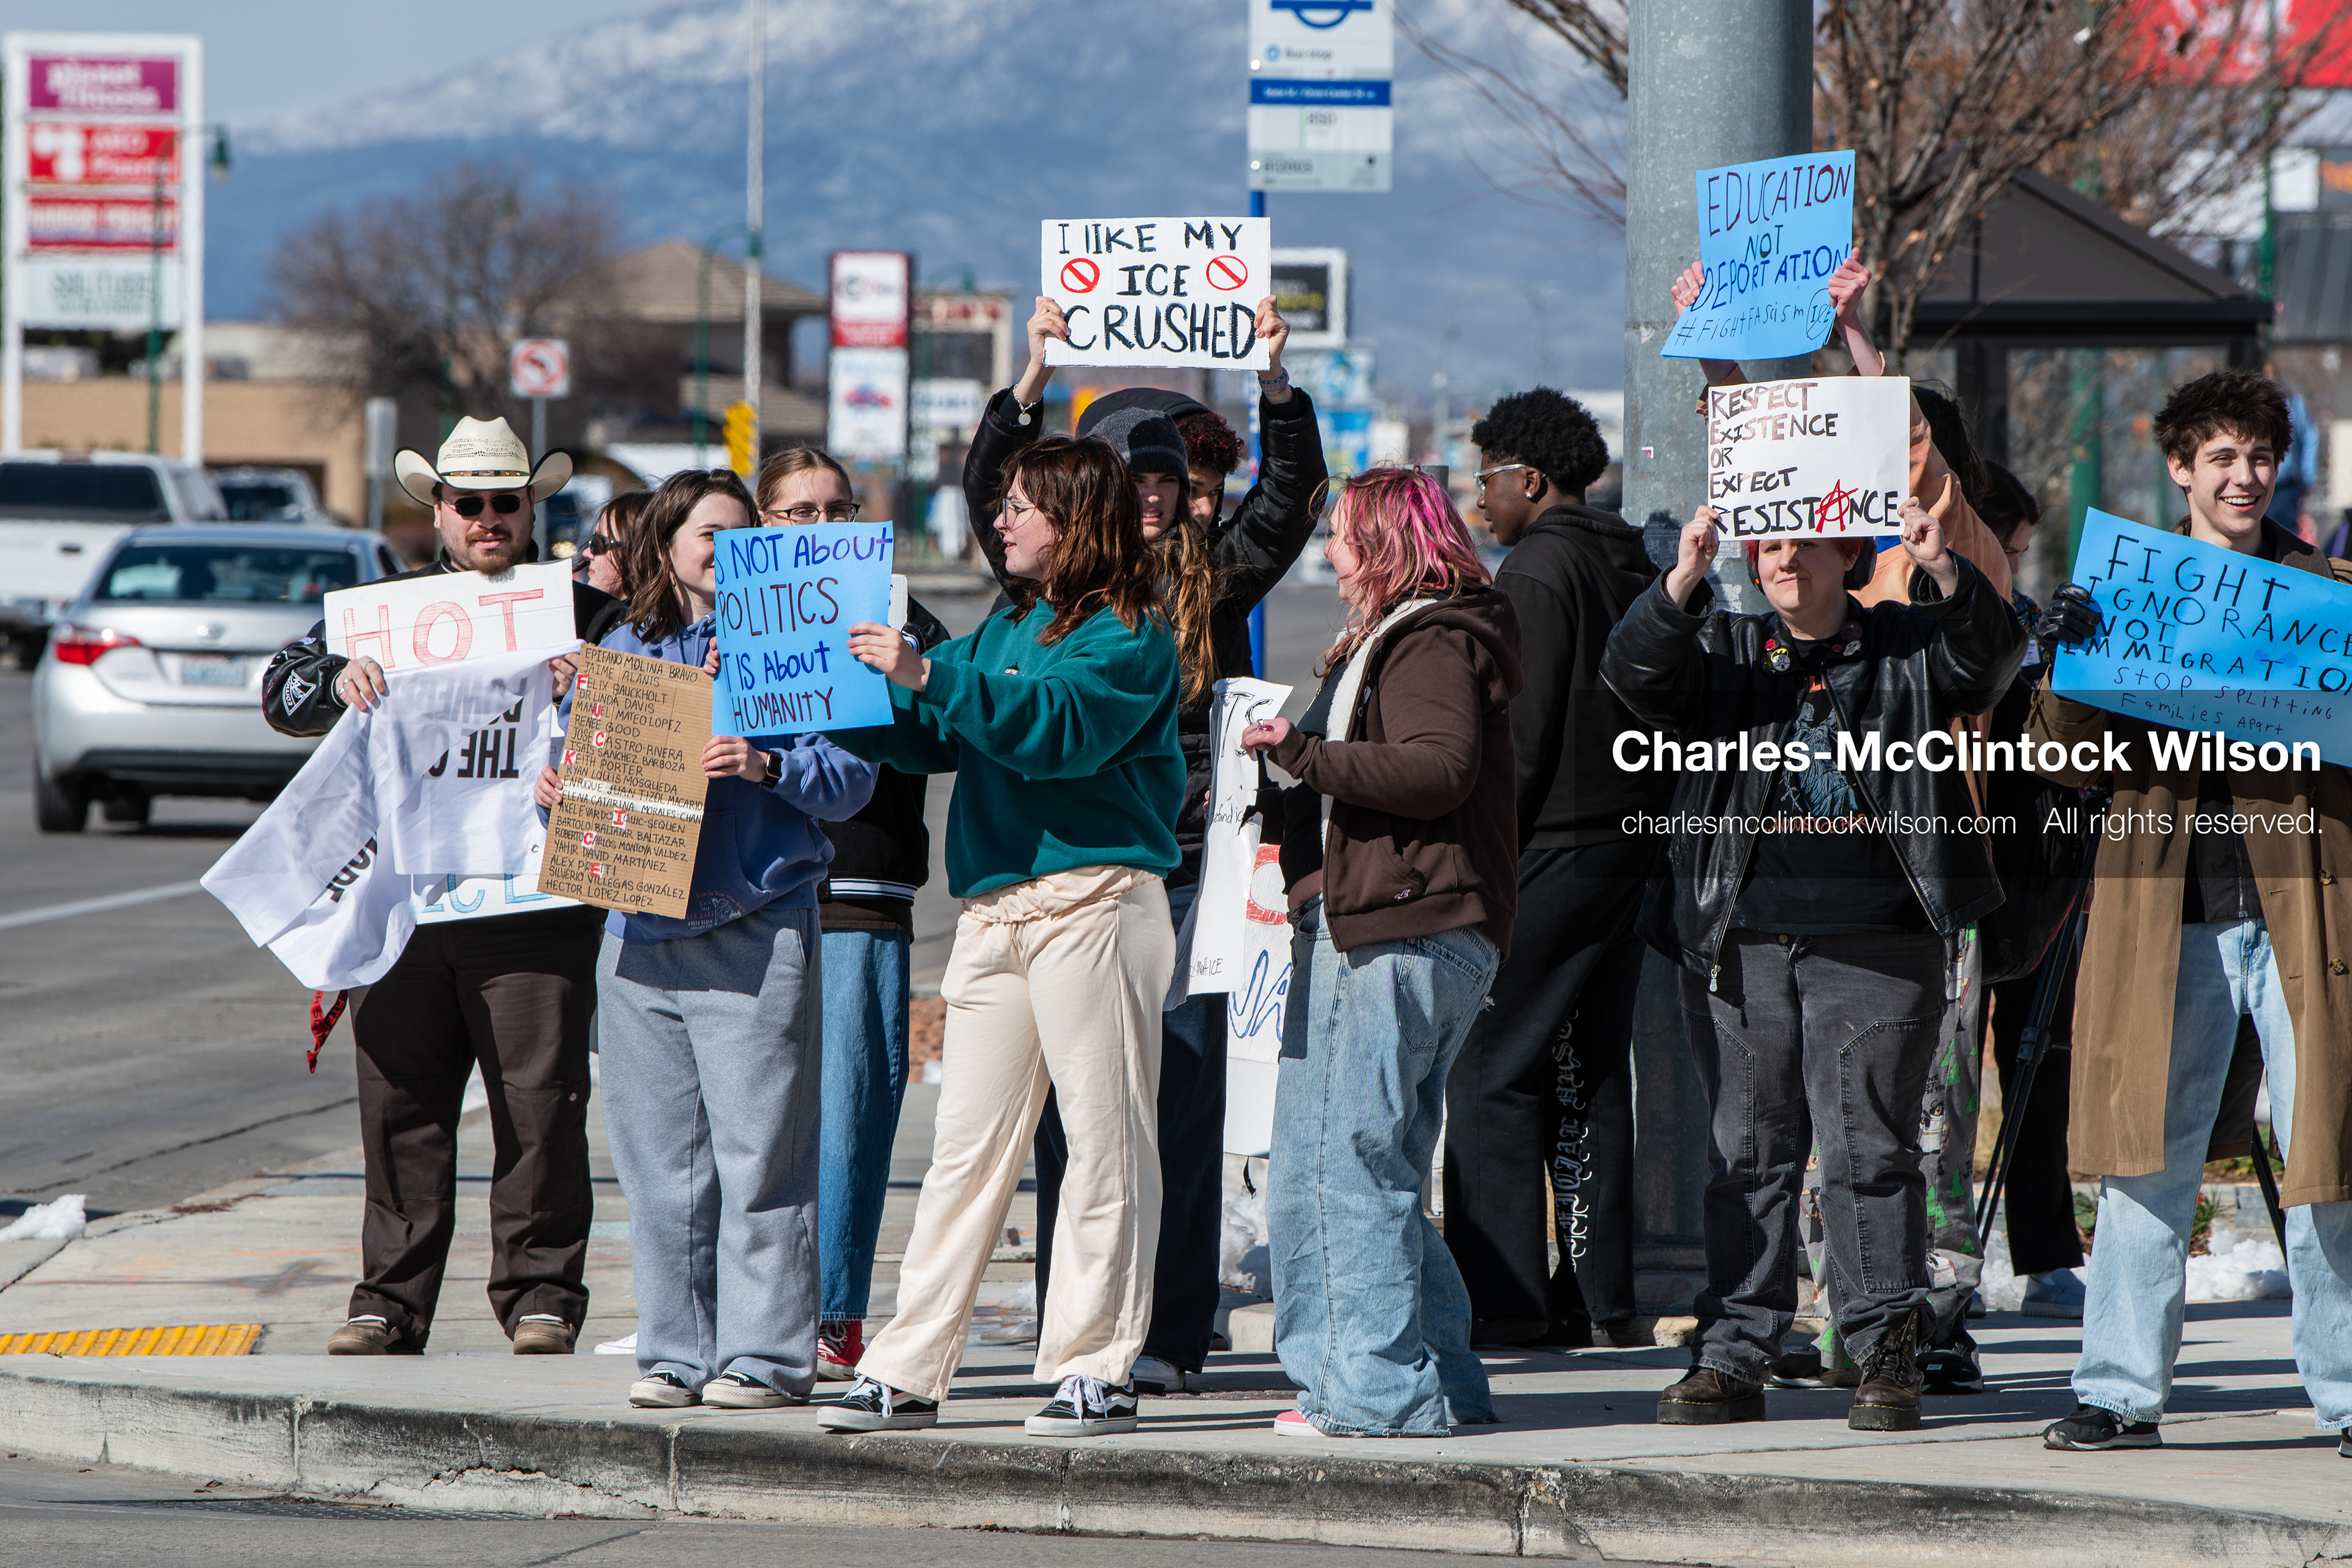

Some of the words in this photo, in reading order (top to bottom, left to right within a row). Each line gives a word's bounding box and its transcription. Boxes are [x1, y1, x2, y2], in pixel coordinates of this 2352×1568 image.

[1708, 164, 1852, 237] EDUCATION
[1058, 223, 1070, 254] I
[1184, 220, 1243, 251] MY
[1744, 225, 1783, 263] NOT
[1117, 263, 1192, 297] ICE
[1691, 243, 1849, 312] DEPORTATION
[1063, 301, 1257, 360] CRUSHED
[1711, 382, 1818, 420] RESPECT
[1710, 413, 1838, 445] EXISTENCE
[1711, 447, 1733, 468] OR
[1710, 467, 1797, 499] EXPECT
[1709, 478, 1900, 537] RESISTANCE
[731, 533, 783, 579] NOT
[794, 527, 893, 568] About
[2108, 535, 2290, 611] FIGHT
[718, 577, 839, 639] POLITICS
[343, 589, 544, 669] HOT
[2099, 615, 2175, 643] NOT
[584, 662, 614, 679] JAIME
[622, 671, 660, 687] ALANIS
[586, 648, 622, 665] EPIFANO
[669, 665, 698, 682] BRAVO
[736, 652, 755, 691] IS
[763, 641, 830, 684] About
[576, 674, 609, 692] FELIX
[613, 684, 668, 704] BAUCKHOLT
[575, 701, 610, 718] MANUEL
[625, 698, 654, 714] DAVIS
[731, 686, 833, 733] HUMANITY
[575, 714, 601, 730] RENEE
[606, 722, 640, 737] GOOD
[573, 727, 594, 744] JOSE
[595, 732, 683, 762] CASTRO-RIVERA
[598, 748, 639, 764] SANCHEZ
[643, 756, 685, 772] BARBOZA
[564, 750, 595, 766] KEITH
[601, 759, 643, 777] PORTER
[567, 765, 589, 776] RYAN
[592, 771, 621, 783] LOUIS
[624, 775, 677, 795] MOSQUEDA
[564, 775, 604, 792] ENRIQUE
[607, 785, 636, 797] JUAN
[638, 789, 664, 804] TIZOL
[667, 796, 703, 812] MACARIO
[590, 796, 635, 812] CATARINA
[555, 827, 584, 842] ROBERTO
[584, 832, 616, 850] CARLOS
[619, 841, 651, 856] MONTOYA
[654, 847, 688, 862] VALDEZ
[557, 816, 591, 830] BARTOLO
[595, 823, 633, 839] BALTAZAR
[637, 831, 686, 848] BALTAZAR
[551, 854, 575, 869] ALEX
[554, 840, 578, 855] YAHIR
[582, 848, 609, 861] DAVID
[612, 854, 668, 872] MARTINEZ
[545, 879, 582, 895] HECTOR
[587, 888, 620, 903] LOPEZ
[624, 892, 654, 907] LOPEZ
[549, 866, 584, 881] SILVERIO
[587, 873, 634, 891] VILLEGAS
